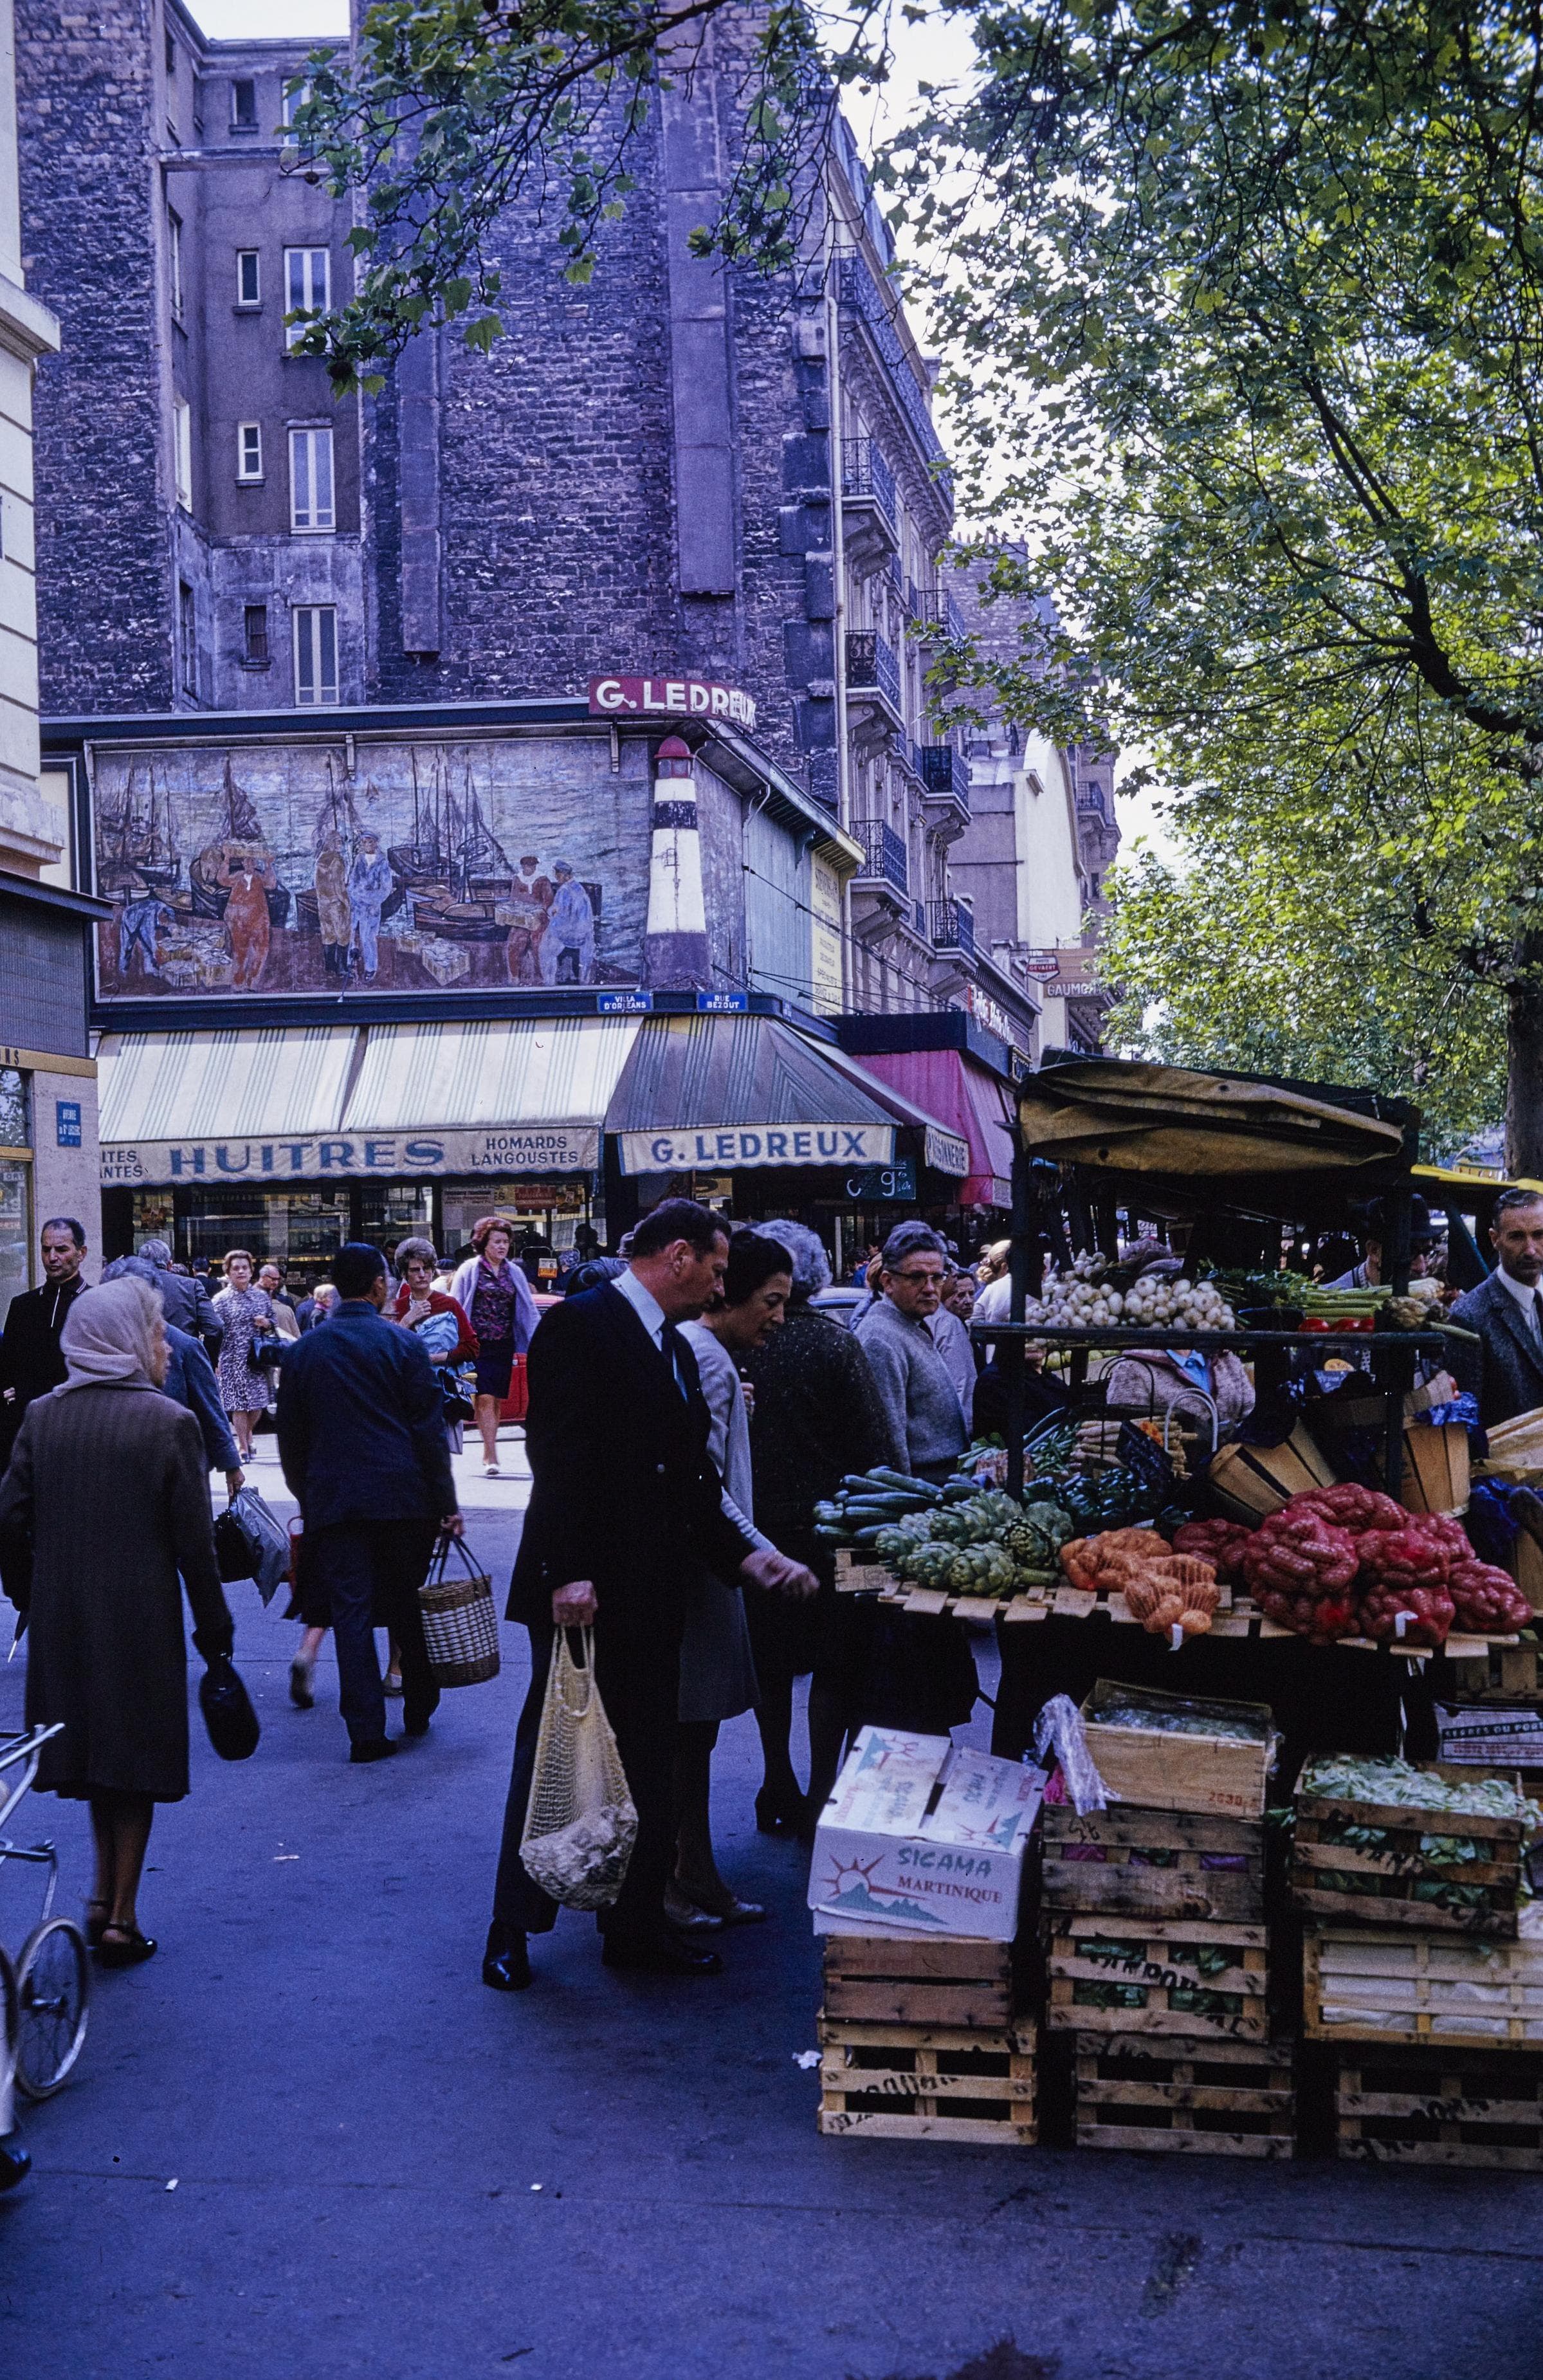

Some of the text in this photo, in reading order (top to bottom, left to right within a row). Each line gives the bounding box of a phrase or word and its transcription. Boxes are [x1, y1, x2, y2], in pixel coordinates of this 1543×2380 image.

[596, 680, 756, 728] G. LEDREUX
[604, 1002, 646, 1011] D'ORLEANS
[169, 1140, 445, 1175] HUITRES
[486, 1136, 567, 1150] HOMARDS
[651, 1131, 866, 1163] G. LEDREUX
[471, 1151, 579, 1166] LANGOUSTES
[897, 1847, 992, 1879] SICAMA
[897, 1875, 1003, 1904] MARTINIQUE
